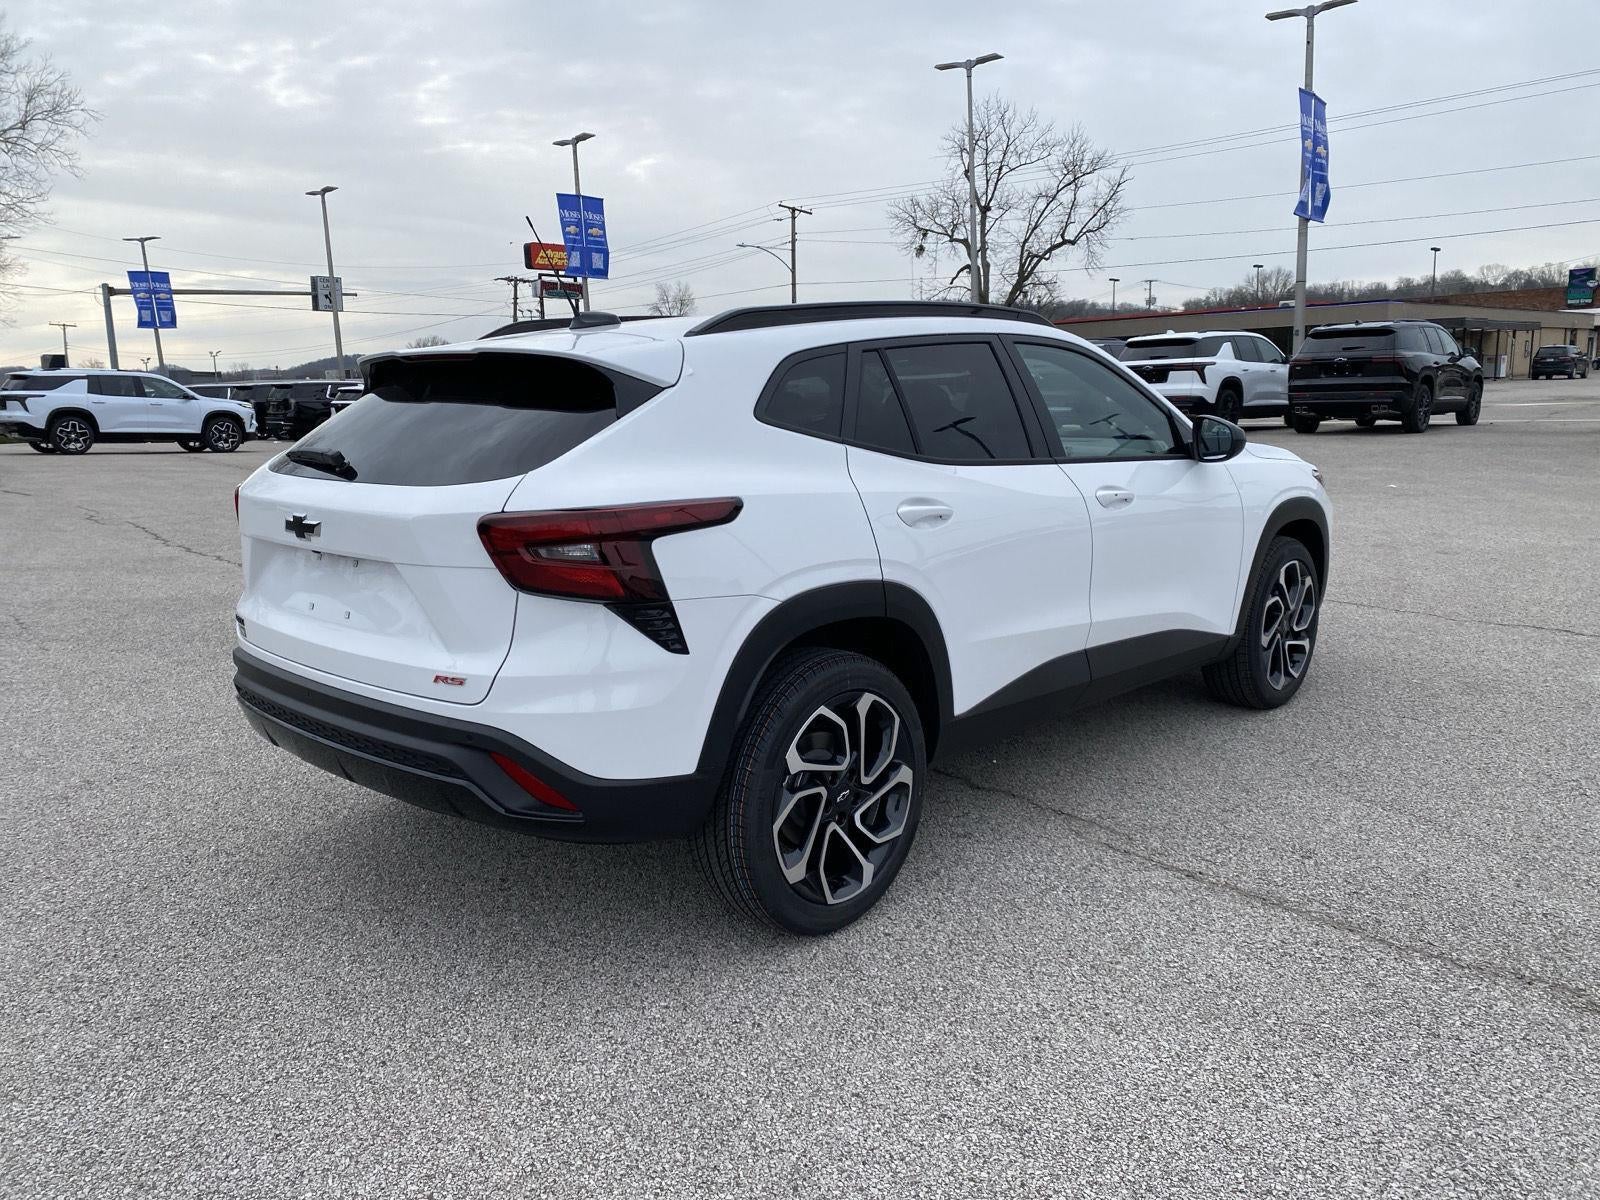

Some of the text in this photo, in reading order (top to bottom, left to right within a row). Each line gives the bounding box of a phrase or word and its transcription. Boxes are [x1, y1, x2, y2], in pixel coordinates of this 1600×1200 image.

[539, 248, 568, 259] Advanc
[553, 257, 569, 266] Part
[433, 674, 467, 686] RS
